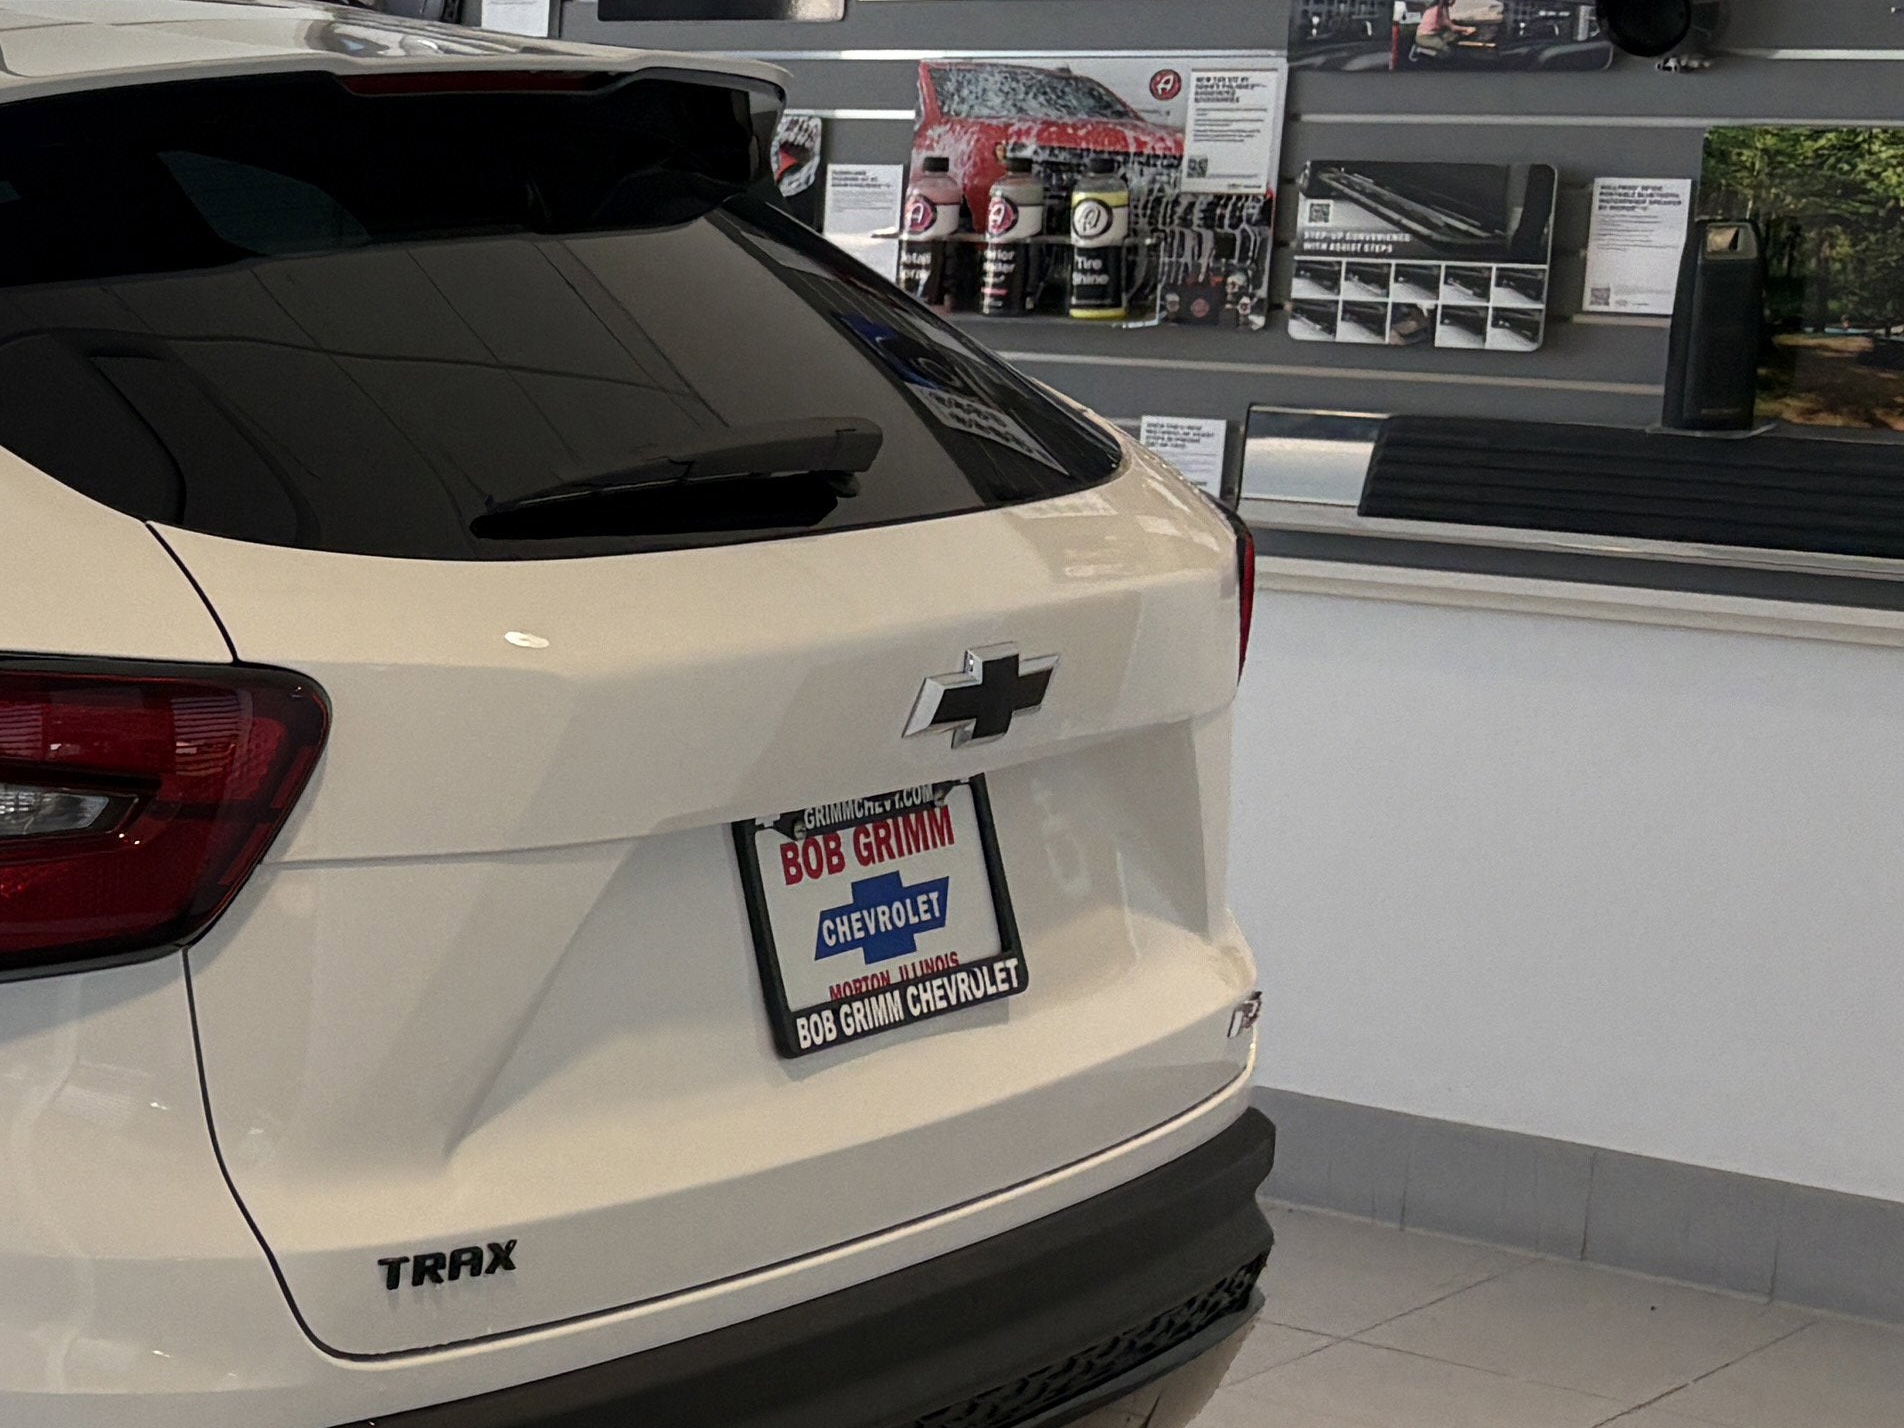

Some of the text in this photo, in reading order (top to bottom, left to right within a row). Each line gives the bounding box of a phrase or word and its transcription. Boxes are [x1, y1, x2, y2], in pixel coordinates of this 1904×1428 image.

[1075, 256, 1103, 270] Tire
[779, 804, 956, 886] BOB GRIMM
[821, 890, 941, 948] CHEVROLET
[795, 957, 1020, 1050] BOB GRIMM CHEVROLET
[377, 1238, 519, 1291] TRAX
